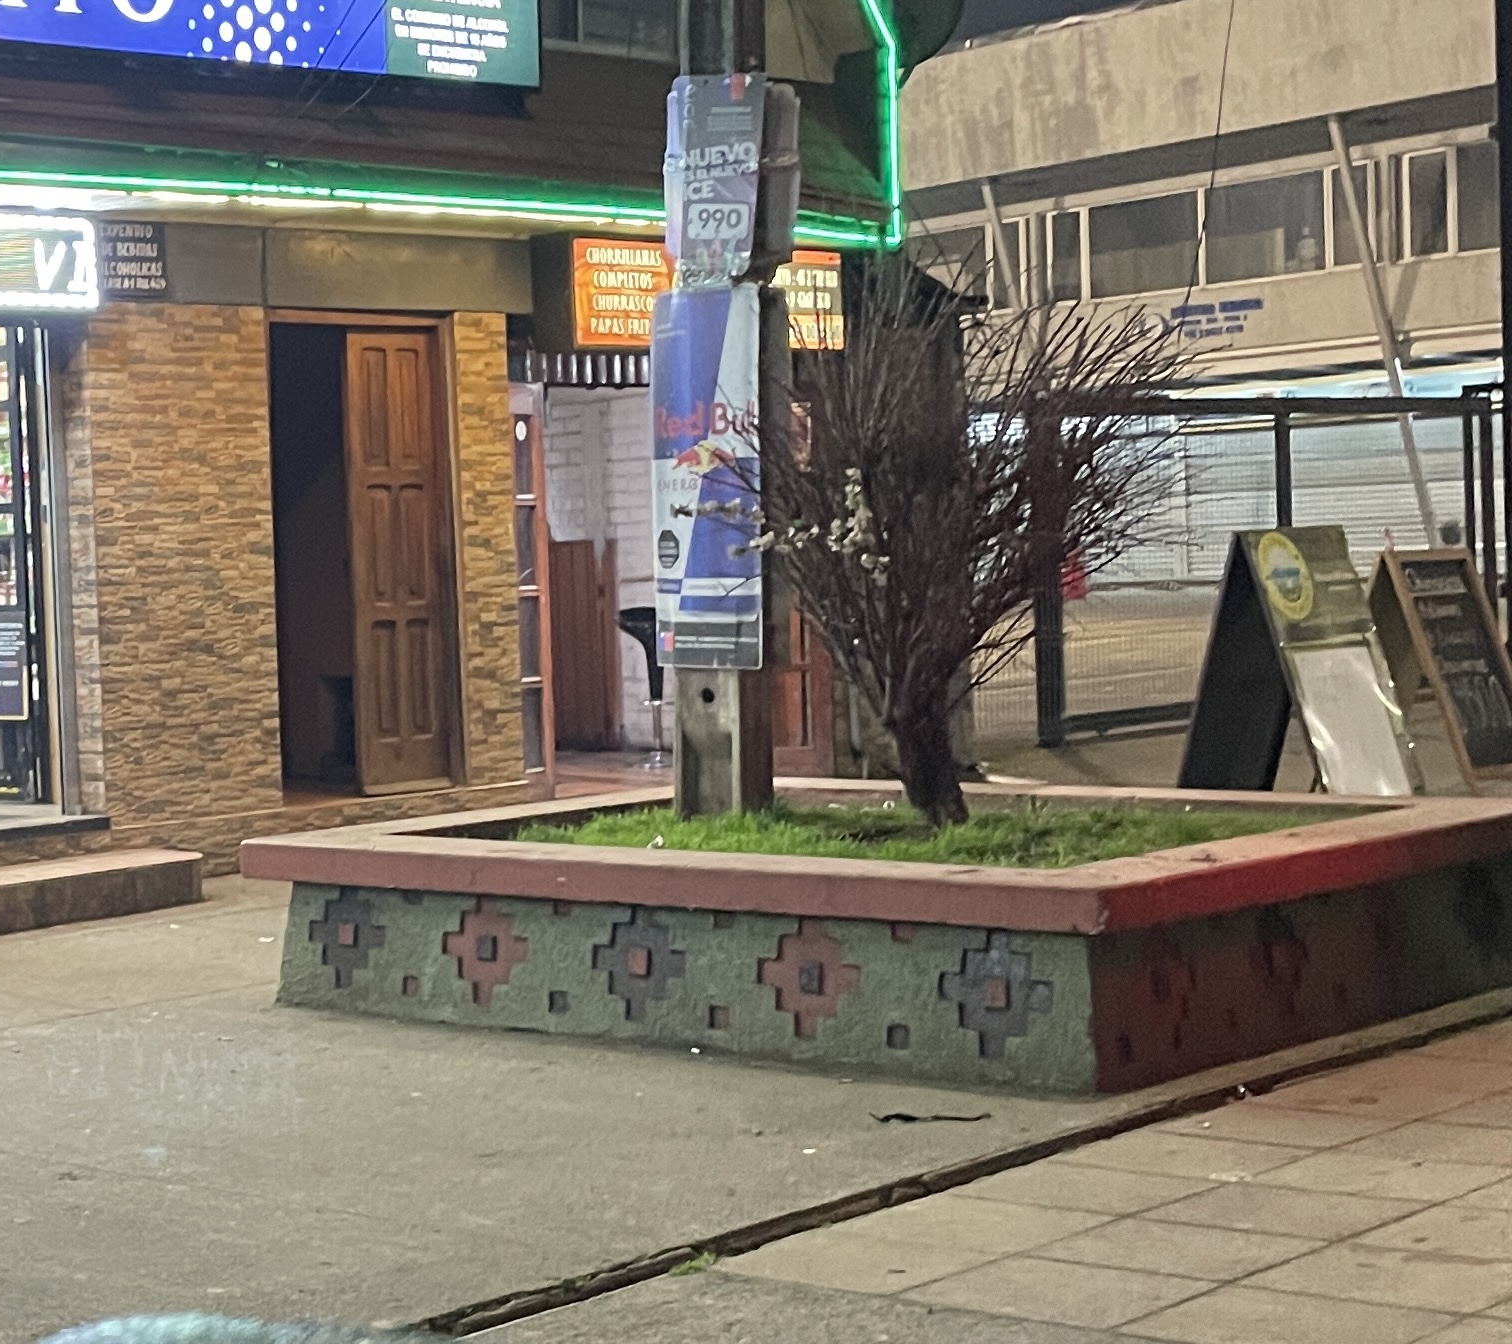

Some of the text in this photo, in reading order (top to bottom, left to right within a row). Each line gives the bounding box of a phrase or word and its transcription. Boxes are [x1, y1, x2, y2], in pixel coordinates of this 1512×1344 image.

[683, 141, 758, 169] NUEVO
[586, 247, 662, 267] CHORRILLANAS
[593, 270, 654, 289] COMPLETOS
[592, 294, 657, 312] CHURRASCO
[590, 317, 651, 335] PAPAS FRIT
[657, 477, 698, 493] ENERG
